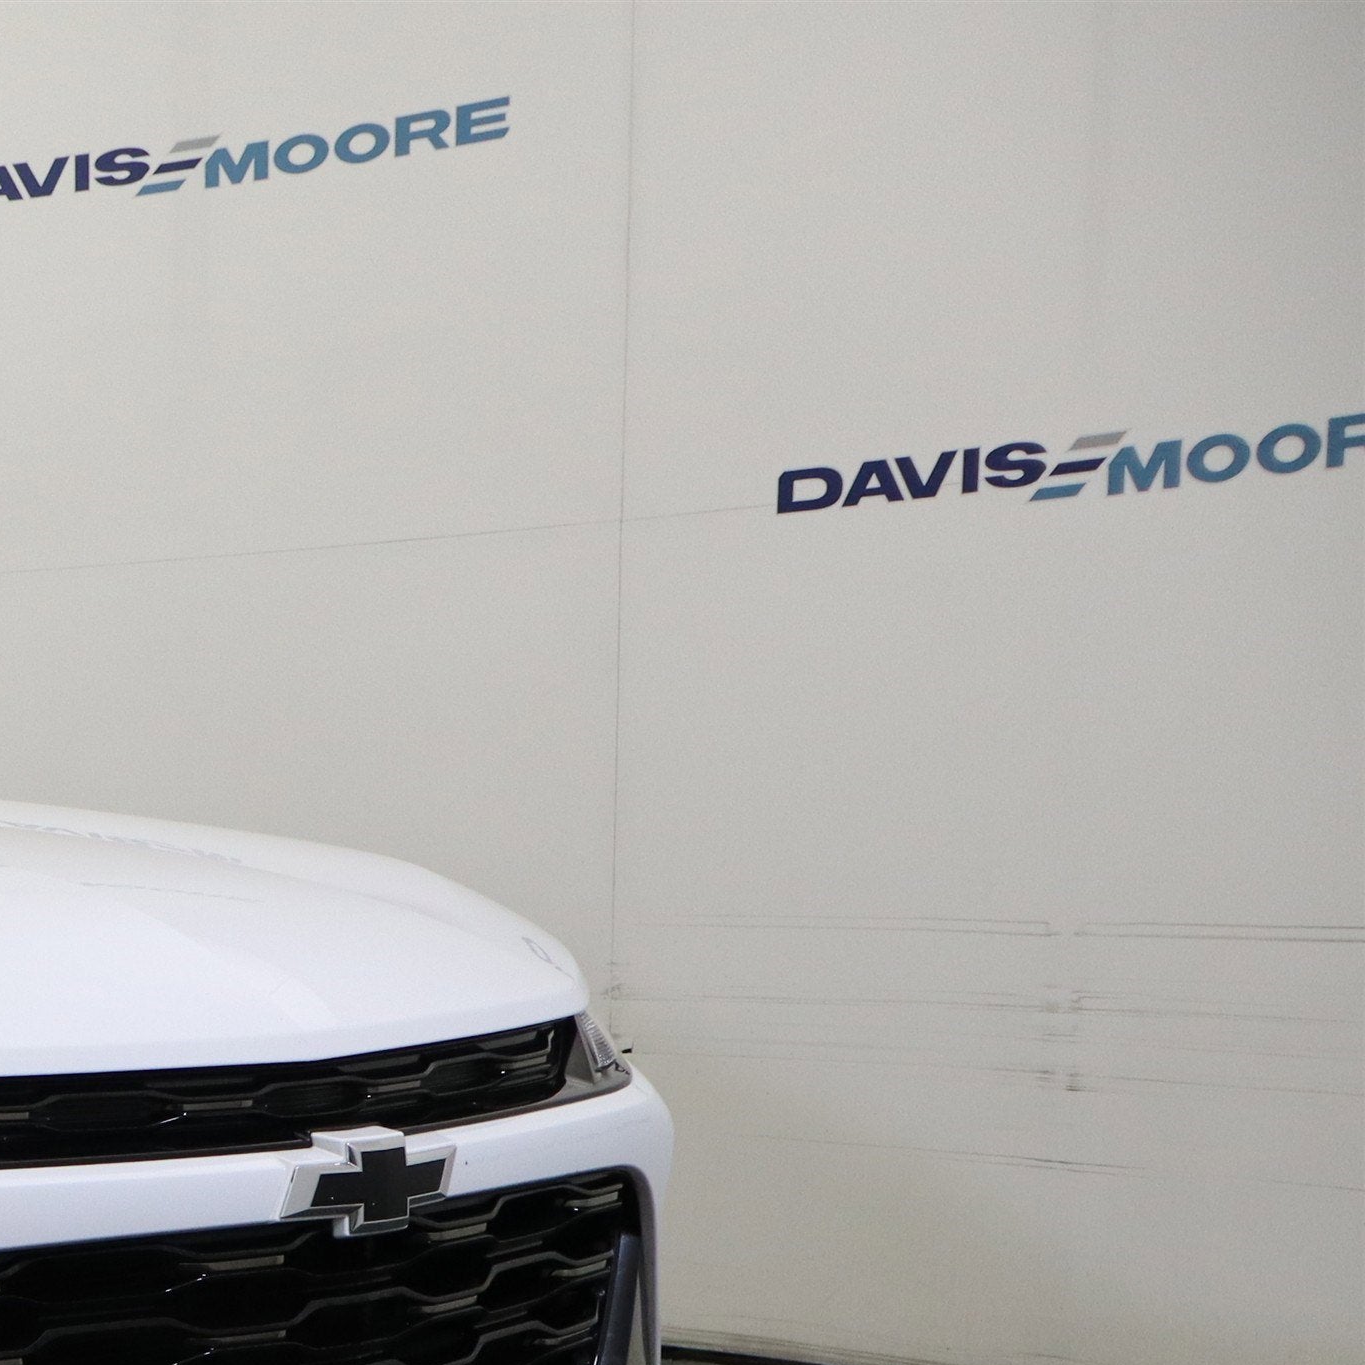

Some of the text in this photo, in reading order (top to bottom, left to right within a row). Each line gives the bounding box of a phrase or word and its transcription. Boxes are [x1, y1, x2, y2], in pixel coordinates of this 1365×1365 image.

[204, 95, 511, 189] MOORE
[776, 412, 1365, 515] DAVIS MOOR
